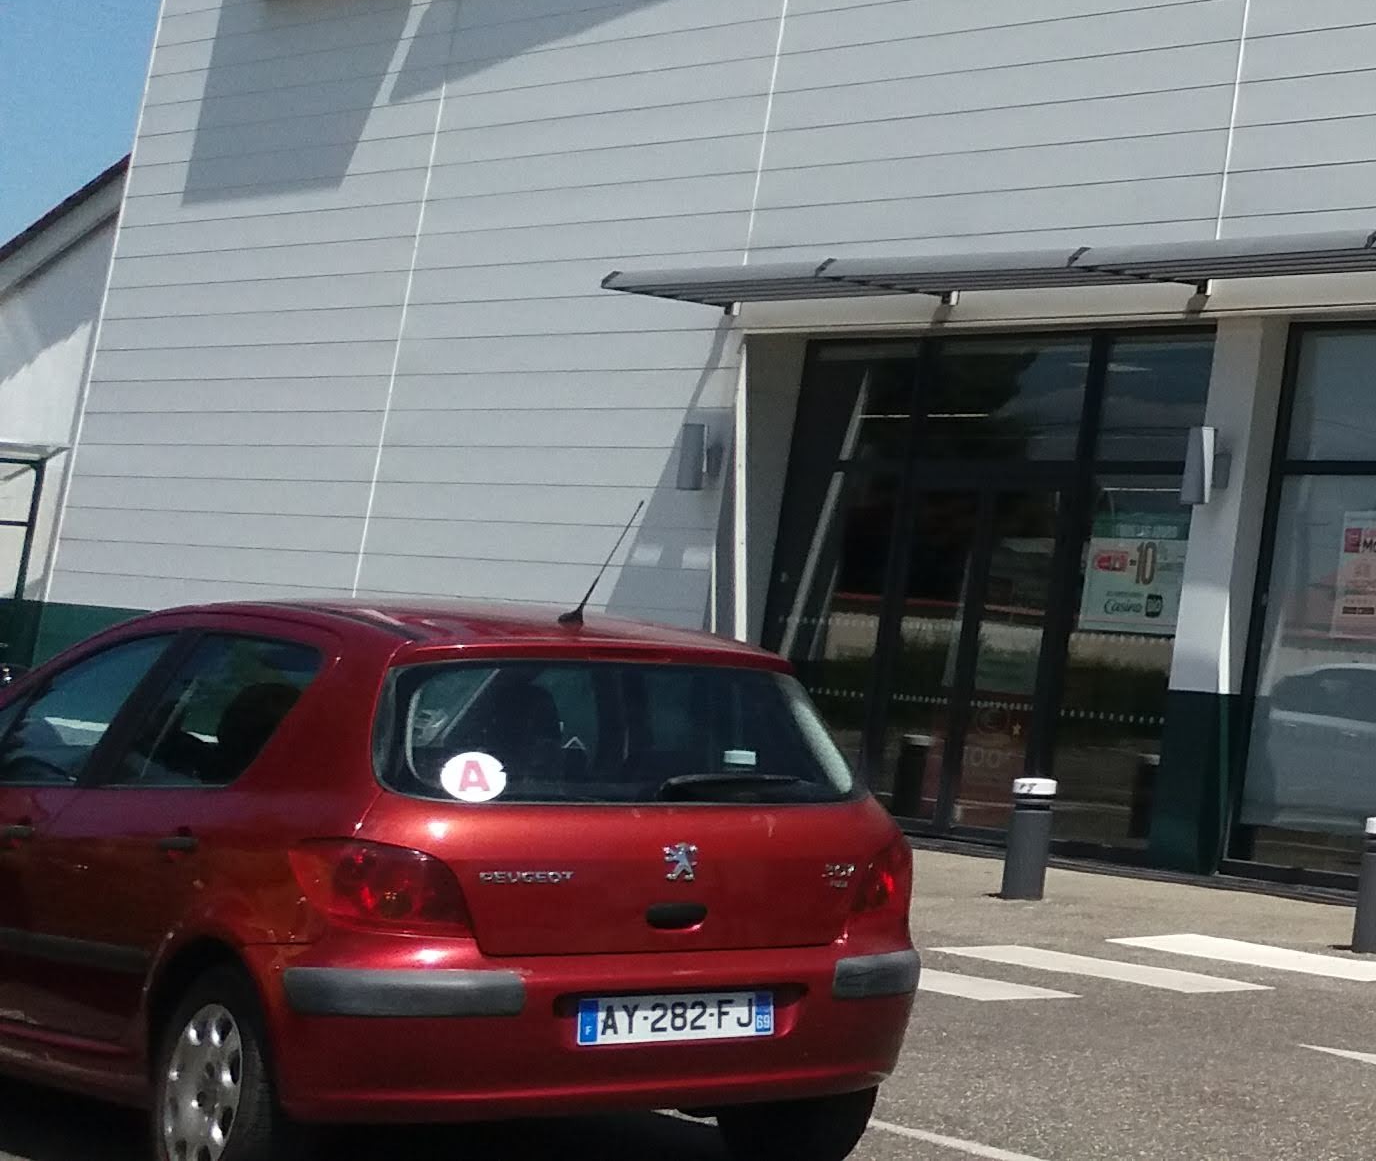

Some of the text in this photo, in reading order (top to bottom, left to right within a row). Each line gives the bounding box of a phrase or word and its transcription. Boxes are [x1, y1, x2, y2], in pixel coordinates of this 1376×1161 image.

[1104, 599, 1143, 615] Casino
[458, 760, 490, 793] A
[479, 870, 574, 884] PEUGEOT
[600, 998, 754, 1037] AY-282-FJ
[756, 1014, 772, 1032] 69
